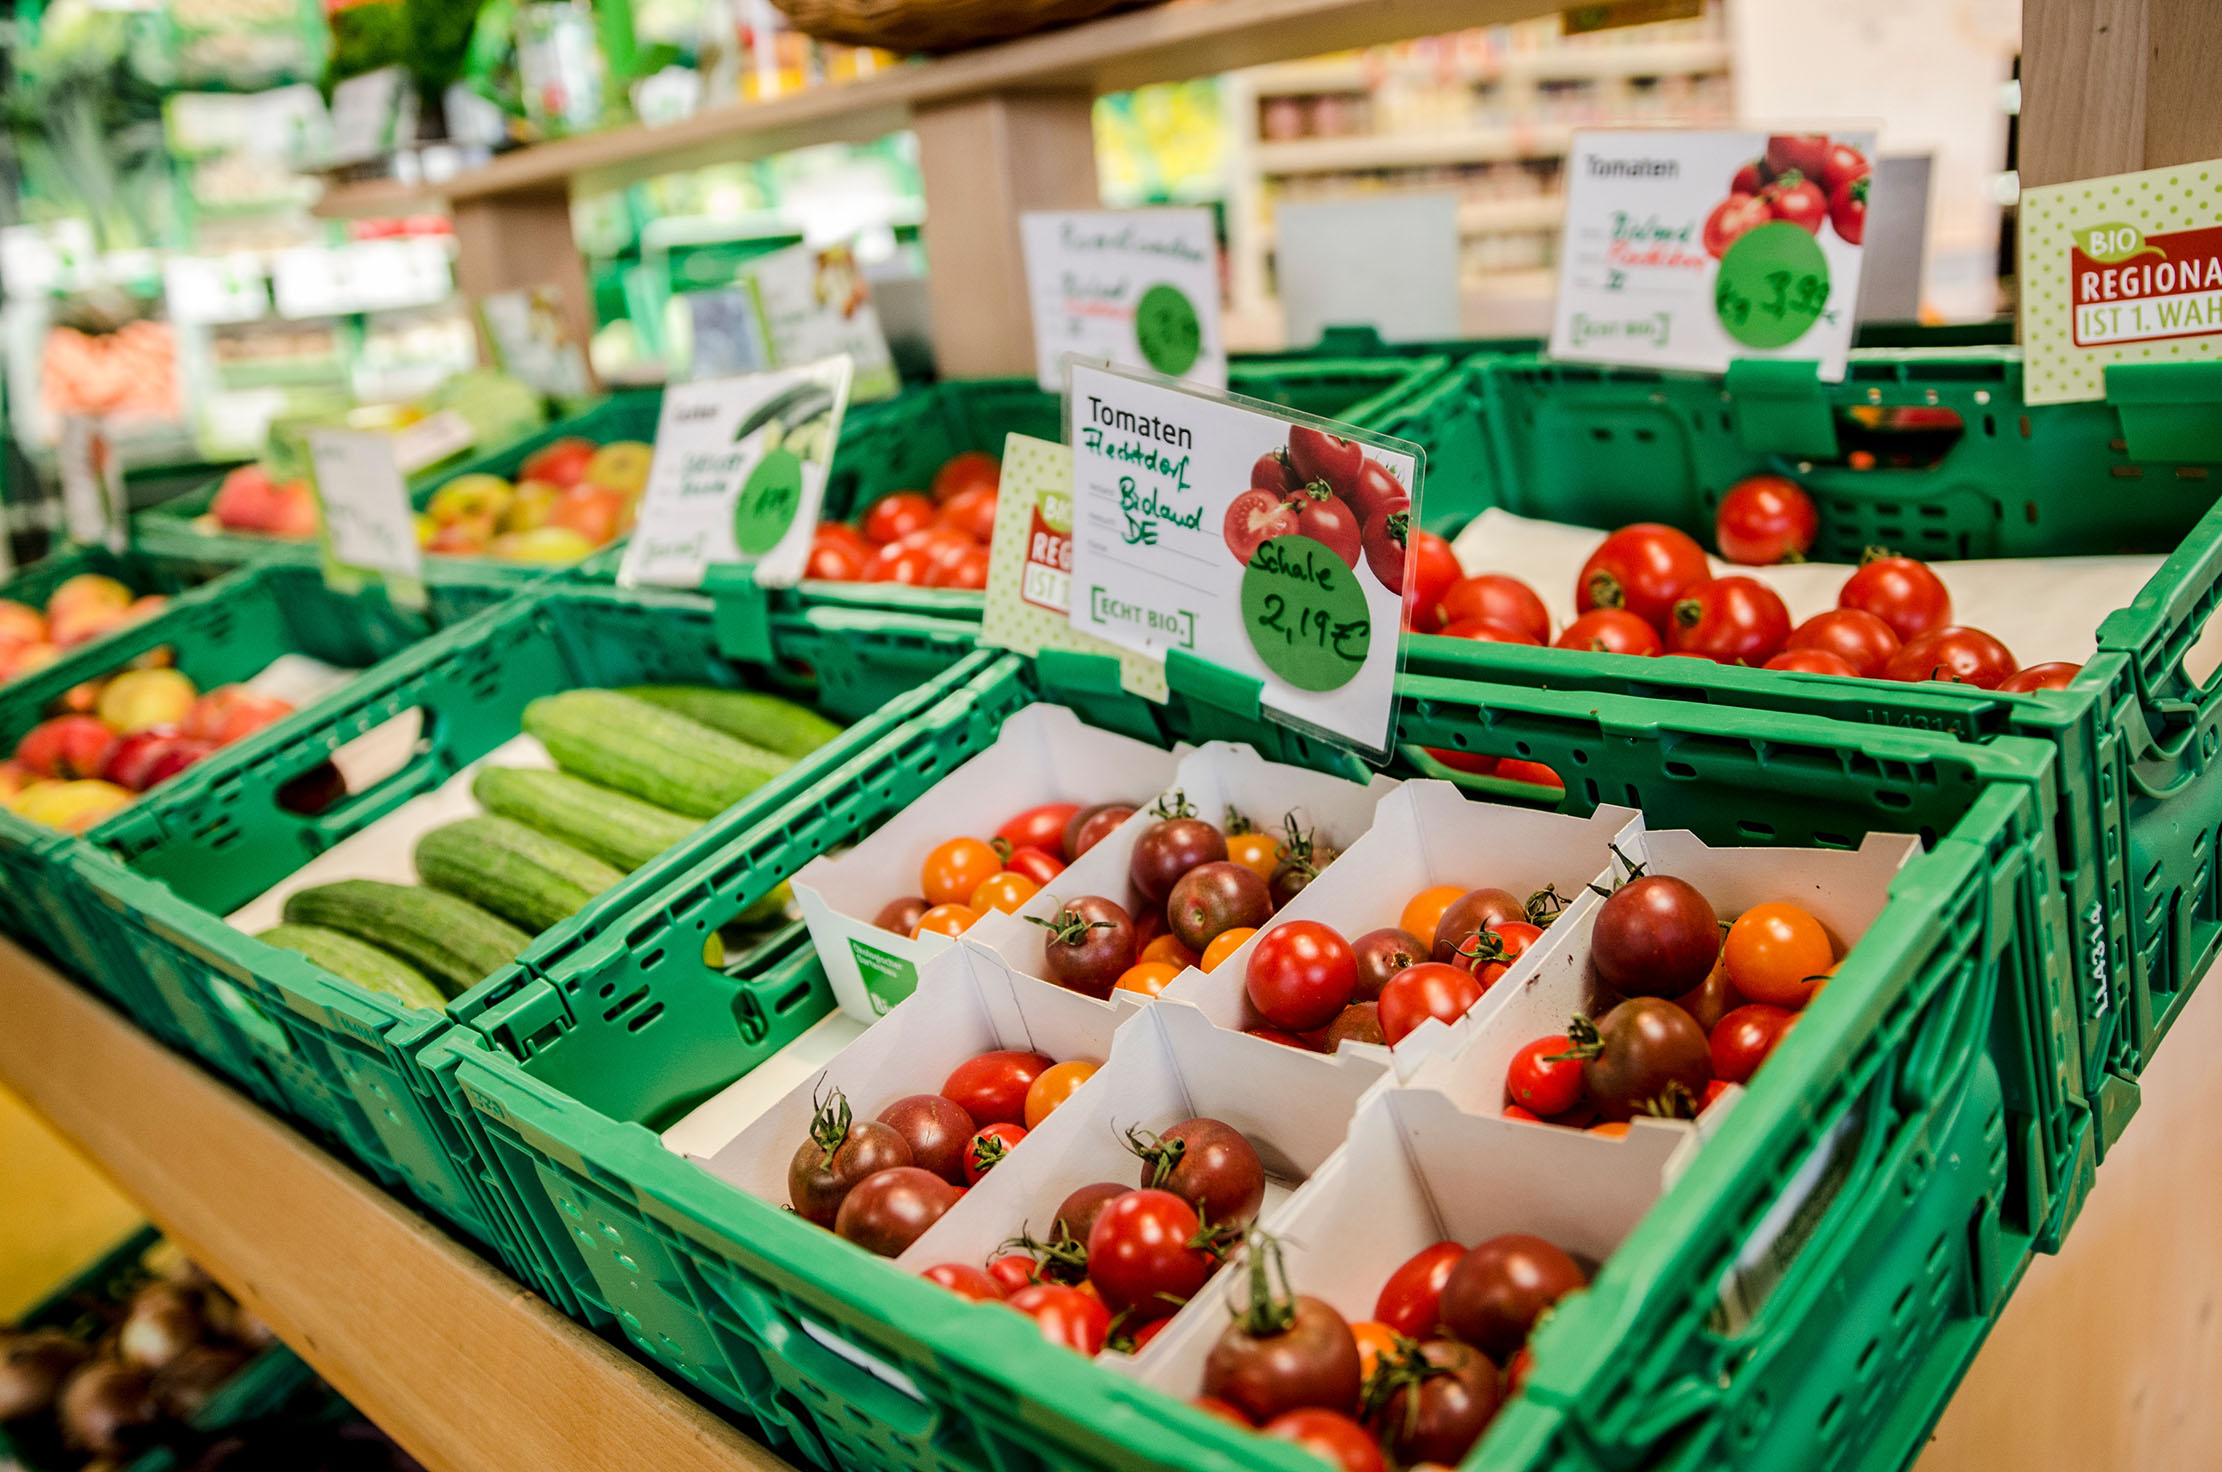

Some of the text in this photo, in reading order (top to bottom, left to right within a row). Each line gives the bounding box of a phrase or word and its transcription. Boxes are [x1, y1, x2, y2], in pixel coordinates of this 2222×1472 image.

[1586, 155, 1679, 178] Tomaten
[2090, 227, 2137, 256] BIO
[2084, 307, 2122, 337] IST
[2131, 305, 2151, 331] 1.
[1088, 396, 1192, 450] Tomaten
[1121, 512, 1158, 546] DE
[1249, 540, 1335, 591] Schale
[1258, 594, 1369, 663] 2,19€
